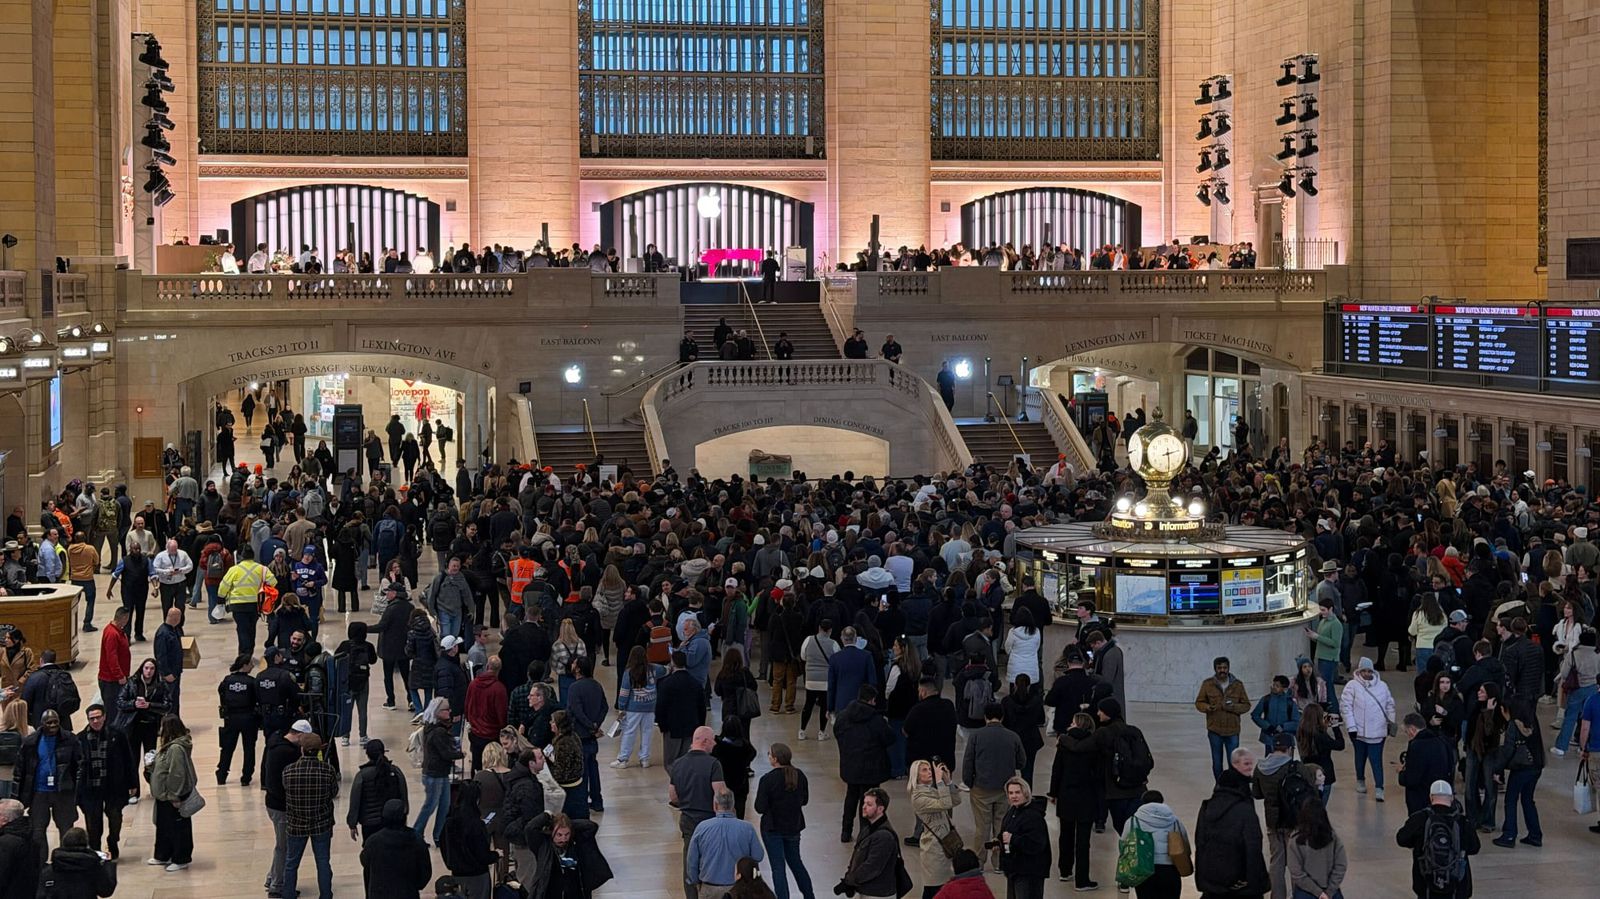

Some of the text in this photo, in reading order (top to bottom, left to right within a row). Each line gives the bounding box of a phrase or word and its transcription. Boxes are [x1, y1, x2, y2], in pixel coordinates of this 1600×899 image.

[563, 337, 602, 346] BALCONY
[952, 333, 989, 342] BALCONY
[1065, 330, 1148, 353] LEXINGTON AVE
[1184, 330, 1273, 353] TICKET MACHINES
[228, 340, 319, 363] TRACKS 21 TO 11
[362, 339, 457, 361] LEXINGTON AVE
[349, 364, 389, 374] SUBWAY
[232, 364, 340, 386] 42ND STREET PASSAGE
[391, 387, 430, 397] lovepop
[813, 416, 841, 425] DINING
[713, 423, 740, 435] TRACKS
[1160, 521, 1199, 531] Information
